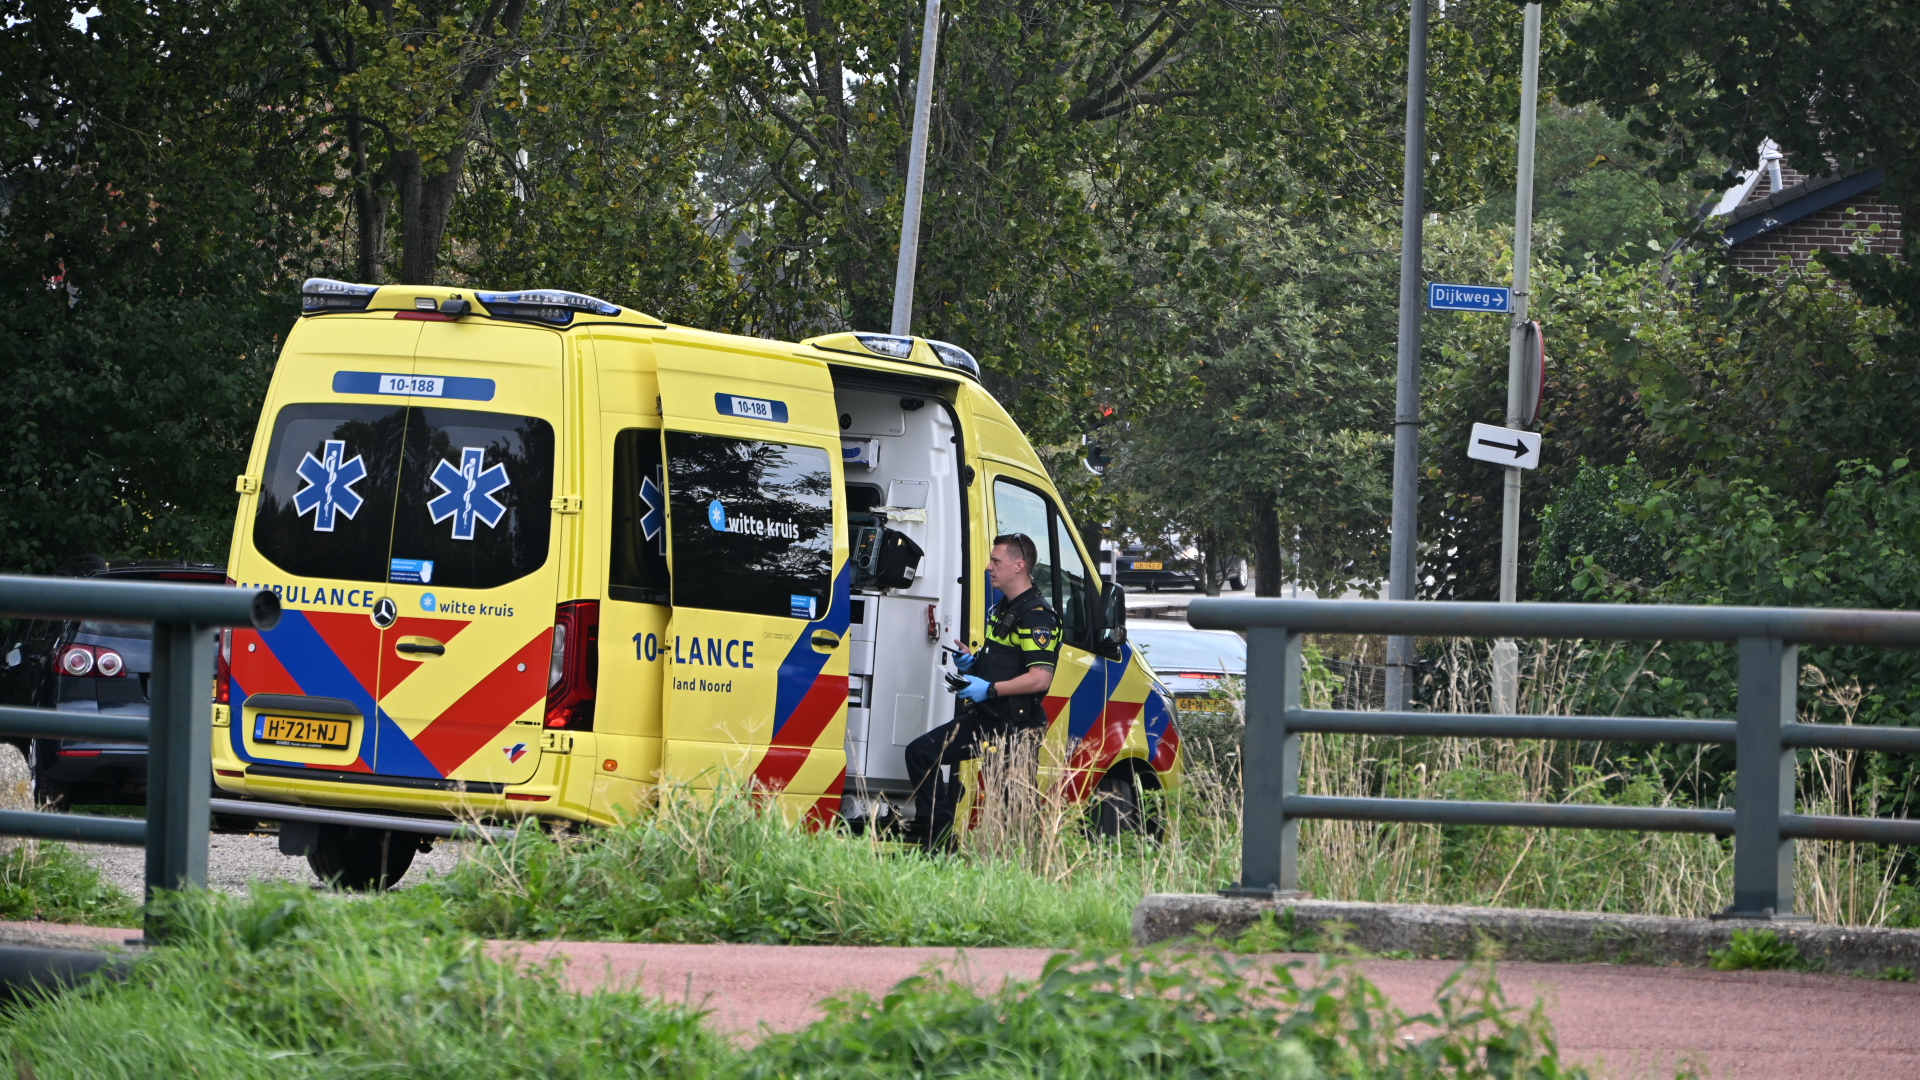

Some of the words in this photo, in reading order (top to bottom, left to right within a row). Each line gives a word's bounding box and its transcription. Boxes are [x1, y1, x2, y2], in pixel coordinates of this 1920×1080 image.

[1436, 288, 1490, 307] Dijkweg
[390, 378, 434, 392] 10-188
[738, 400, 767, 415] 10-188
[728, 512, 764, 536] witte
[767, 517, 799, 539] kruis
[241, 582, 375, 608] BULANCE
[440, 600, 476, 614] witte
[480, 603, 514, 617] kruis
[675, 635, 754, 669] LANCE
[673, 677, 696, 691] land
[699, 679, 732, 693] Noord
[268, 720, 337, 742] H-721-NJ
